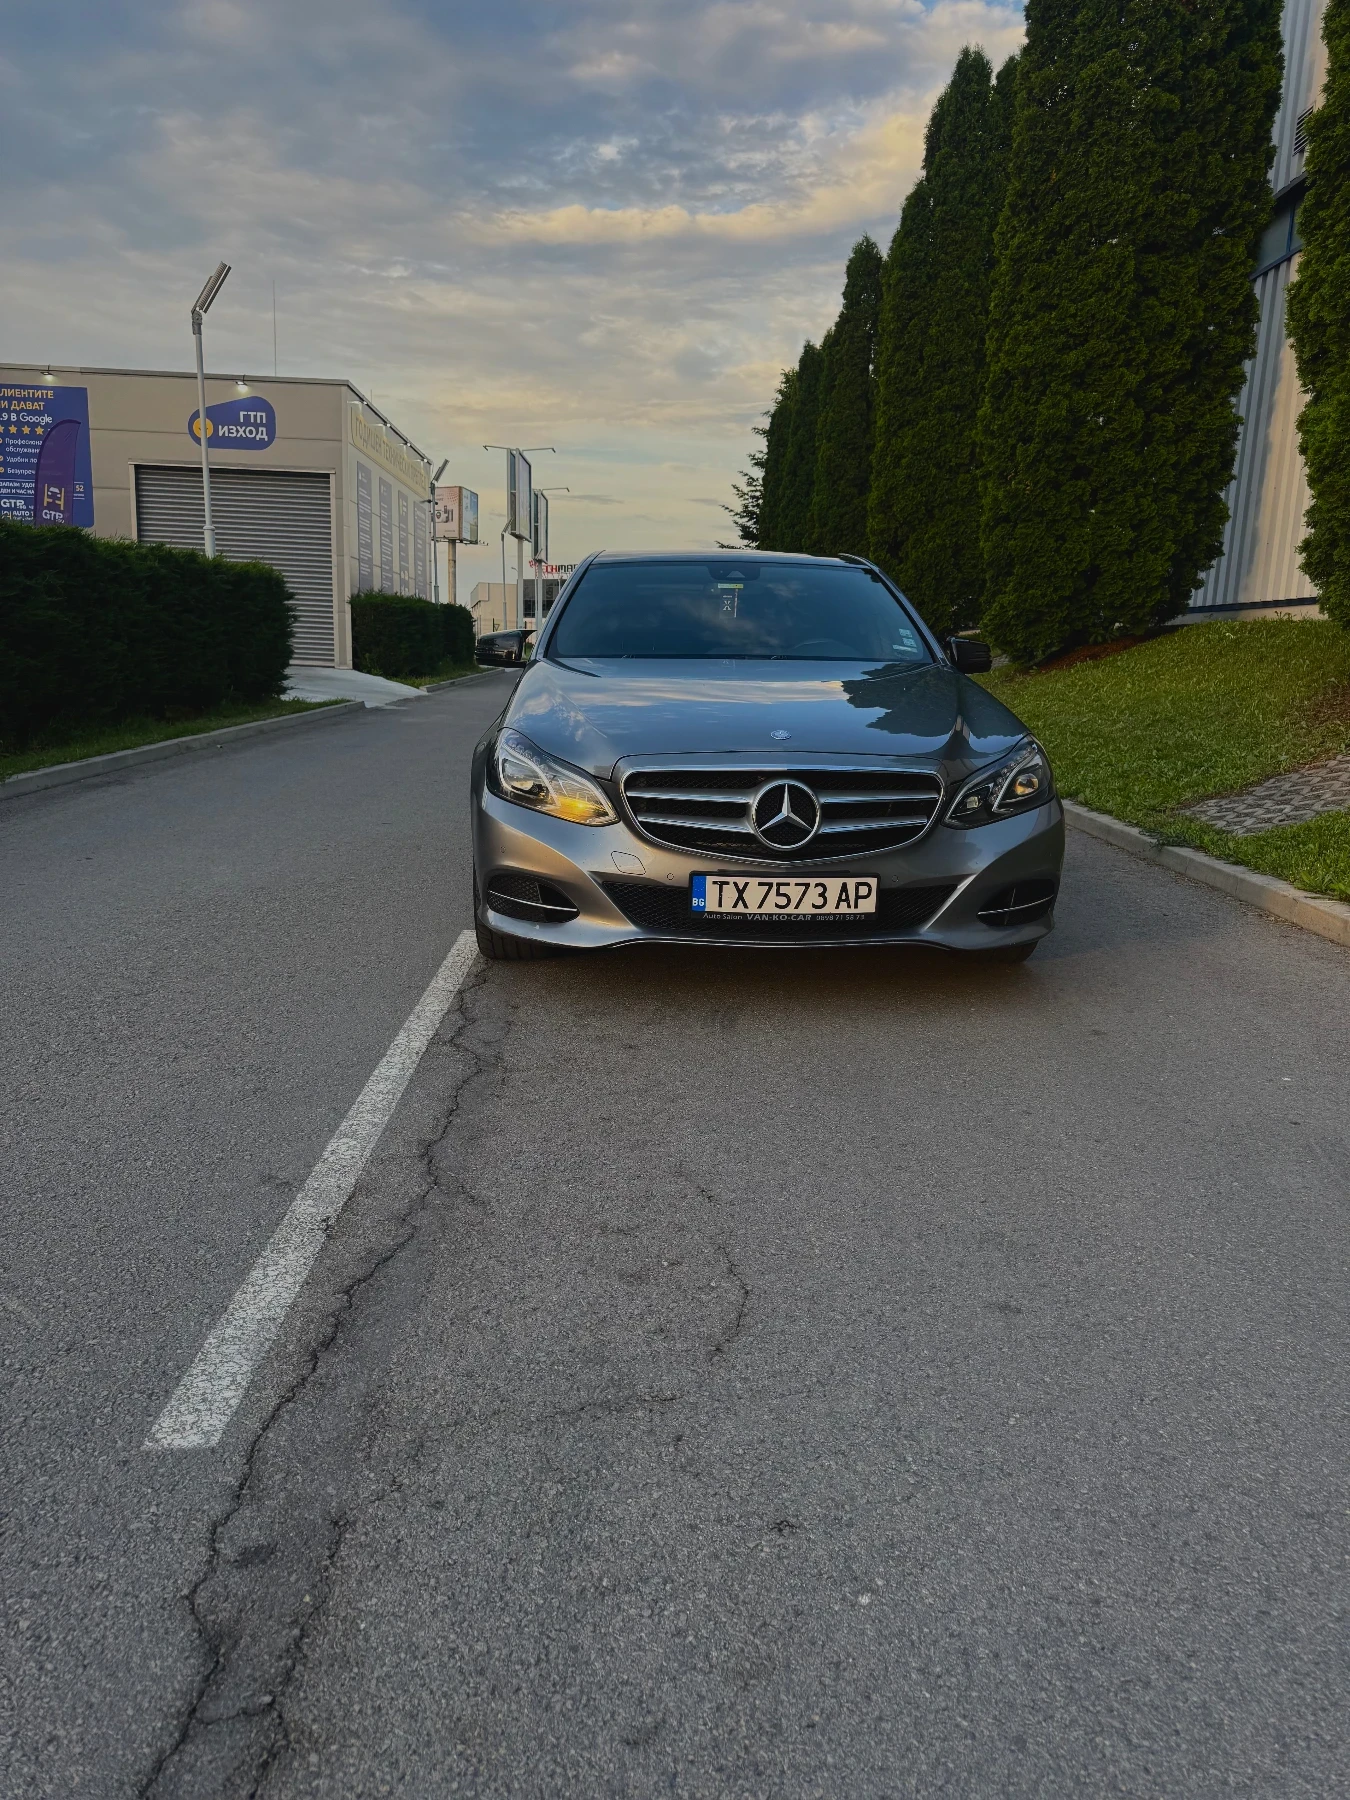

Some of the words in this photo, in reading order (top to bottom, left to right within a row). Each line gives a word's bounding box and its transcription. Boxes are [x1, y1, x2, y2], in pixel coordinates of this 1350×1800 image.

[11, 401, 45, 411] ДАВАТ
[20, 412, 53, 425] Google
[240, 410, 266, 423] ГТП
[218, 425, 268, 441] ИЗХОД
[0, 499, 25, 508] GTP
[42, 509, 64, 520] GTP
[692, 897, 705, 907] BG
[712, 881, 750, 909] TX
[757, 882, 828, 910] 7573
[835, 882, 873, 910] AP
[746, 913, 812, 921] VAN-KO-CAR
